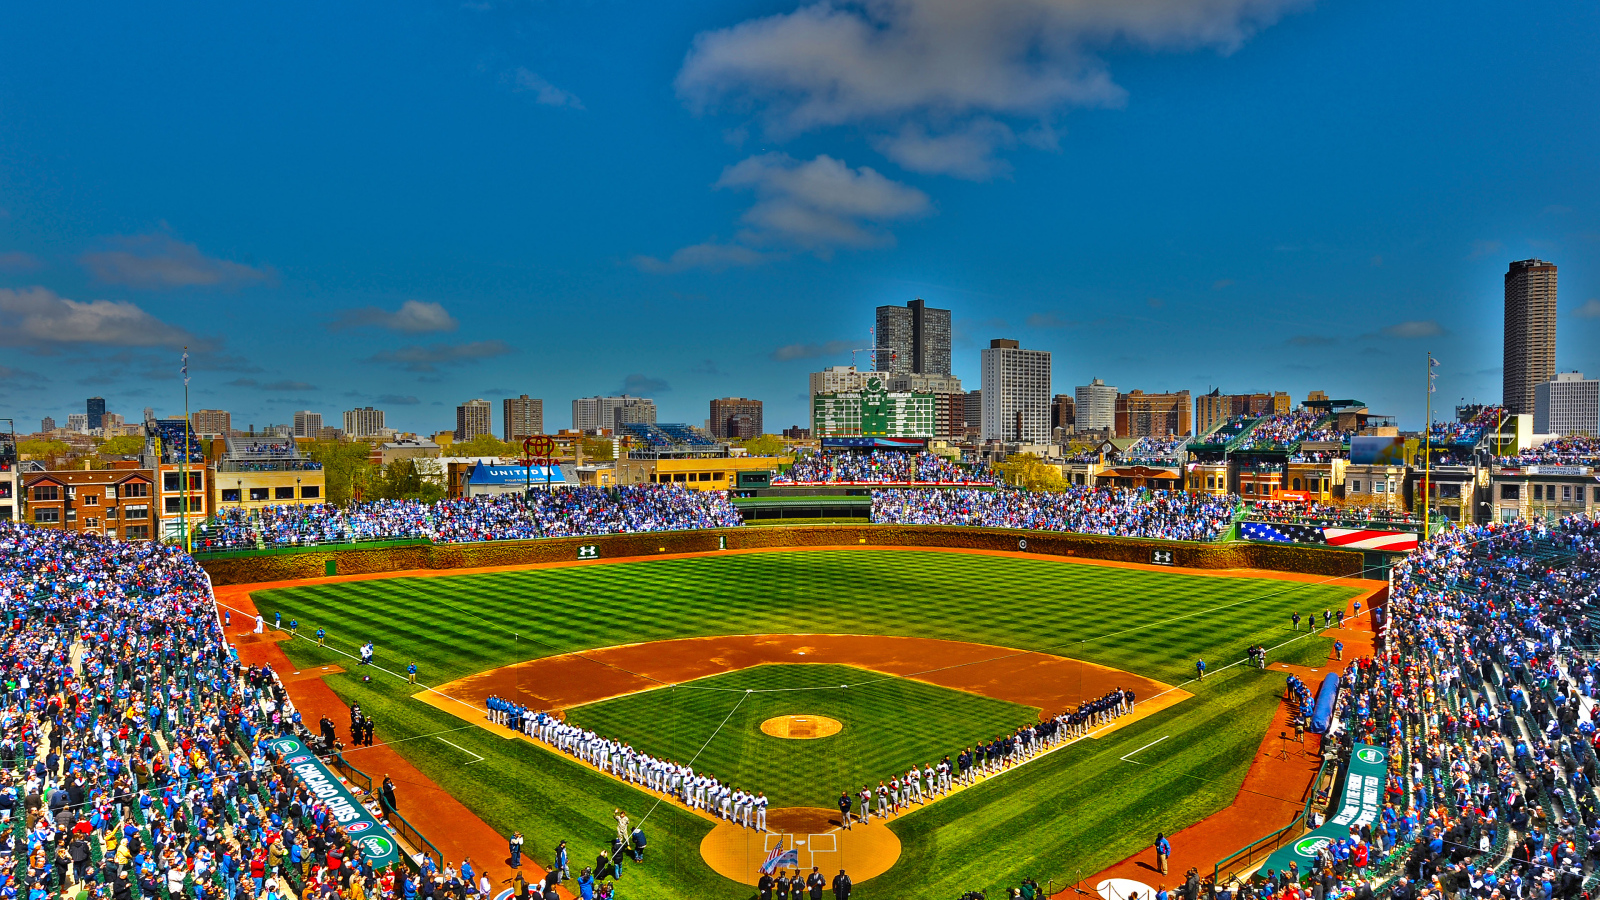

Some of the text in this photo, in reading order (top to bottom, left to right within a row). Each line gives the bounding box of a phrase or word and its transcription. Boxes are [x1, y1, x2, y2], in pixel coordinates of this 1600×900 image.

[518, 459, 560, 467] TOYOTA
[295, 763, 338, 798] CHICAGO
[324, 796, 360, 822] CUBS
